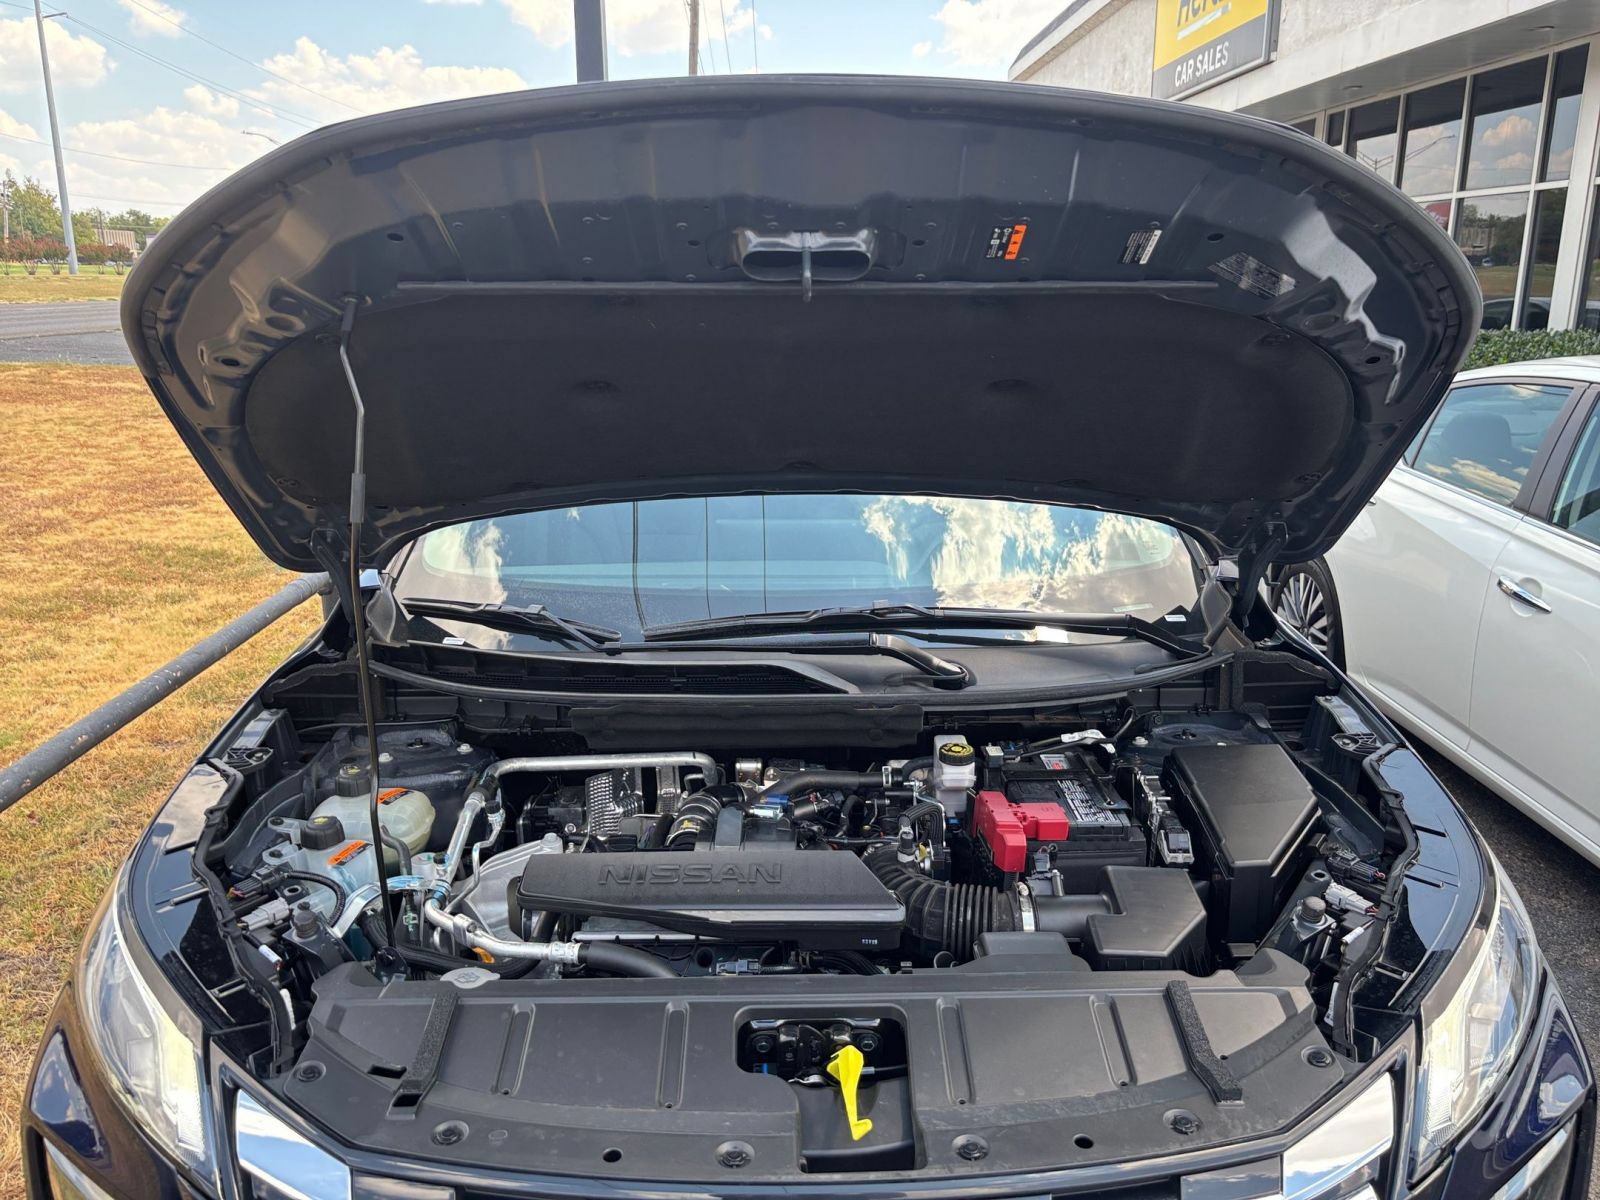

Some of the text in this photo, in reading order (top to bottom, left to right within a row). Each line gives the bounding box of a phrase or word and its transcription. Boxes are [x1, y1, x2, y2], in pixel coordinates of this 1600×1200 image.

[1175, 41, 1229, 88] CAR SALES
[598, 863, 782, 885] NISSAN
